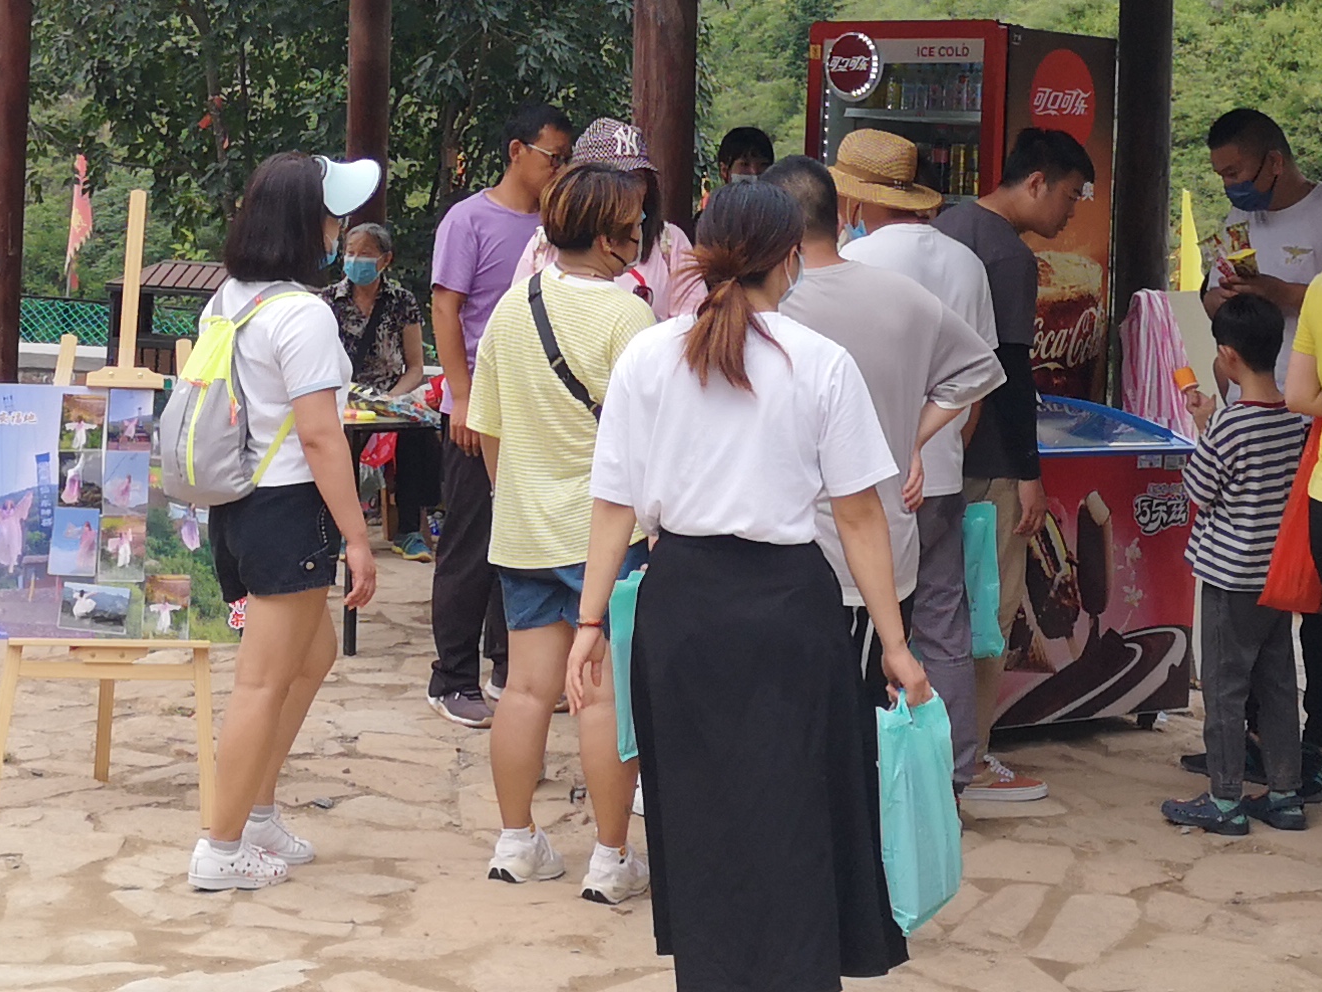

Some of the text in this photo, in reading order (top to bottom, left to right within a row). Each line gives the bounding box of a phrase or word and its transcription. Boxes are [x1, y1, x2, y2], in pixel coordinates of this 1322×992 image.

[916, 45, 970, 58] ICE COLD
[828, 54, 871, 72] 可口可乐
[1032, 86, 1093, 117] 可口可乐
